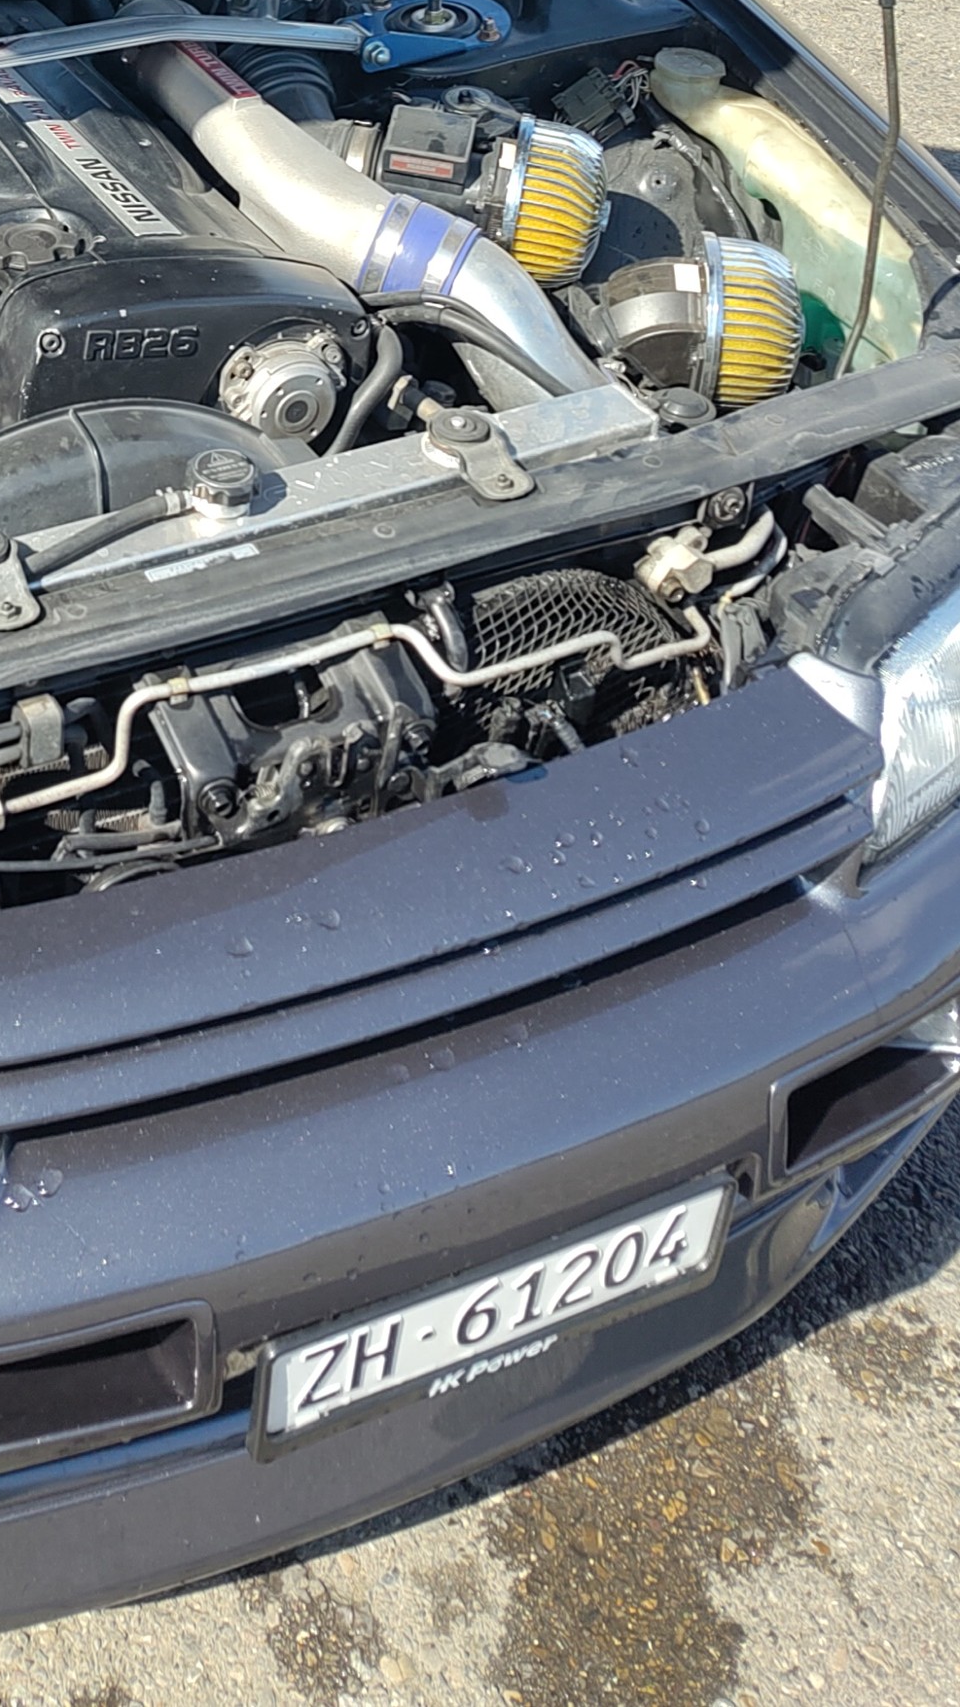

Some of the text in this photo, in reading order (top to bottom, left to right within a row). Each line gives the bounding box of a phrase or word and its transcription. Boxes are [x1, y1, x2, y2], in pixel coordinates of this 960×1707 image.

[45, 123, 82, 151] TWIN
[75, 158, 161, 222] NISSAN
[83, 325, 201, 361] RB26
[294, 1314, 403, 1413] ZH
[453, 1205, 688, 1347] 61204
[466, 1334, 558, 1383] Power
